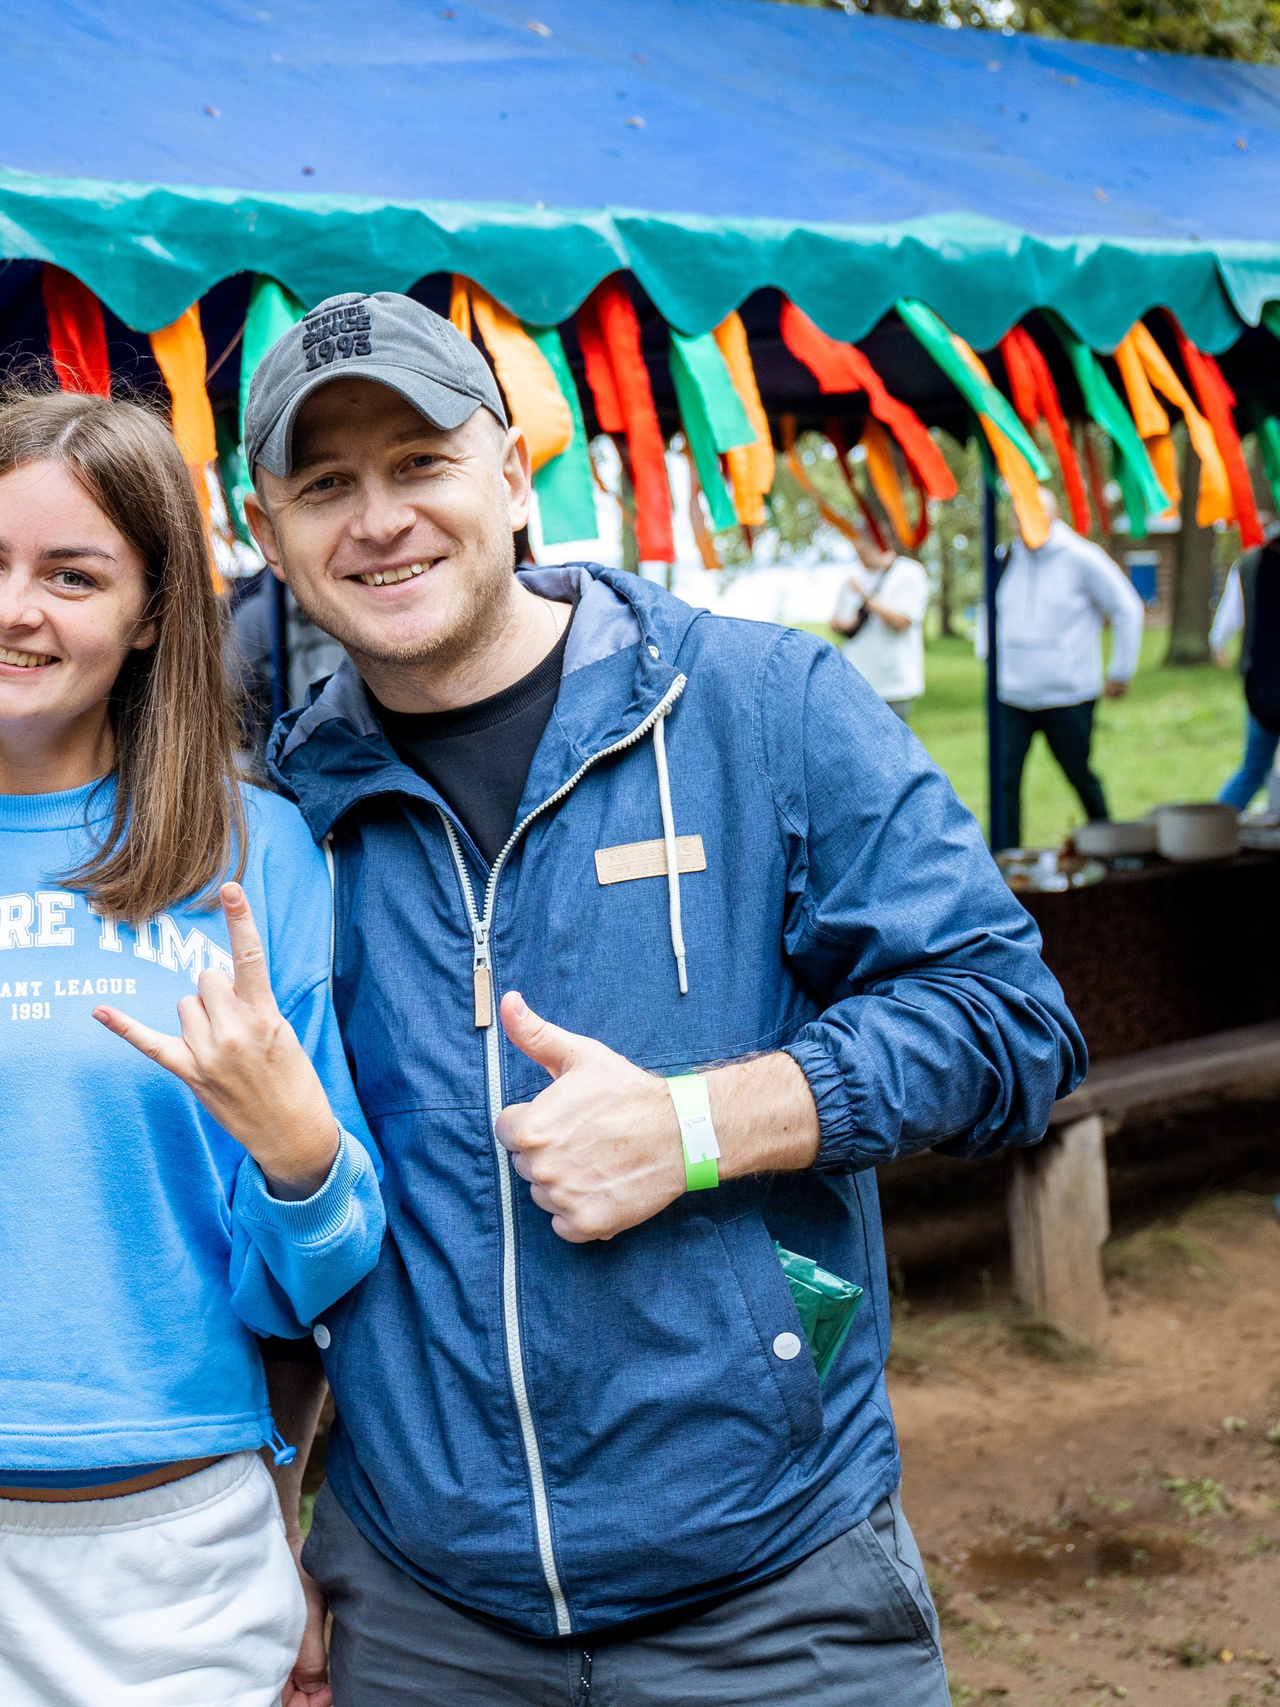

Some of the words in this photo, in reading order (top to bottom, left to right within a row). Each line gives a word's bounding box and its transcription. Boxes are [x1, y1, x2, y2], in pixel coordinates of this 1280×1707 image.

[303, 315, 372, 350] SINCE
[306, 332, 372, 372] 1993
[609, 843, 690, 863] AUTHENIC
[54, 978, 137, 996] LEAGUE
[11, 1003, 51, 1020] 1991
